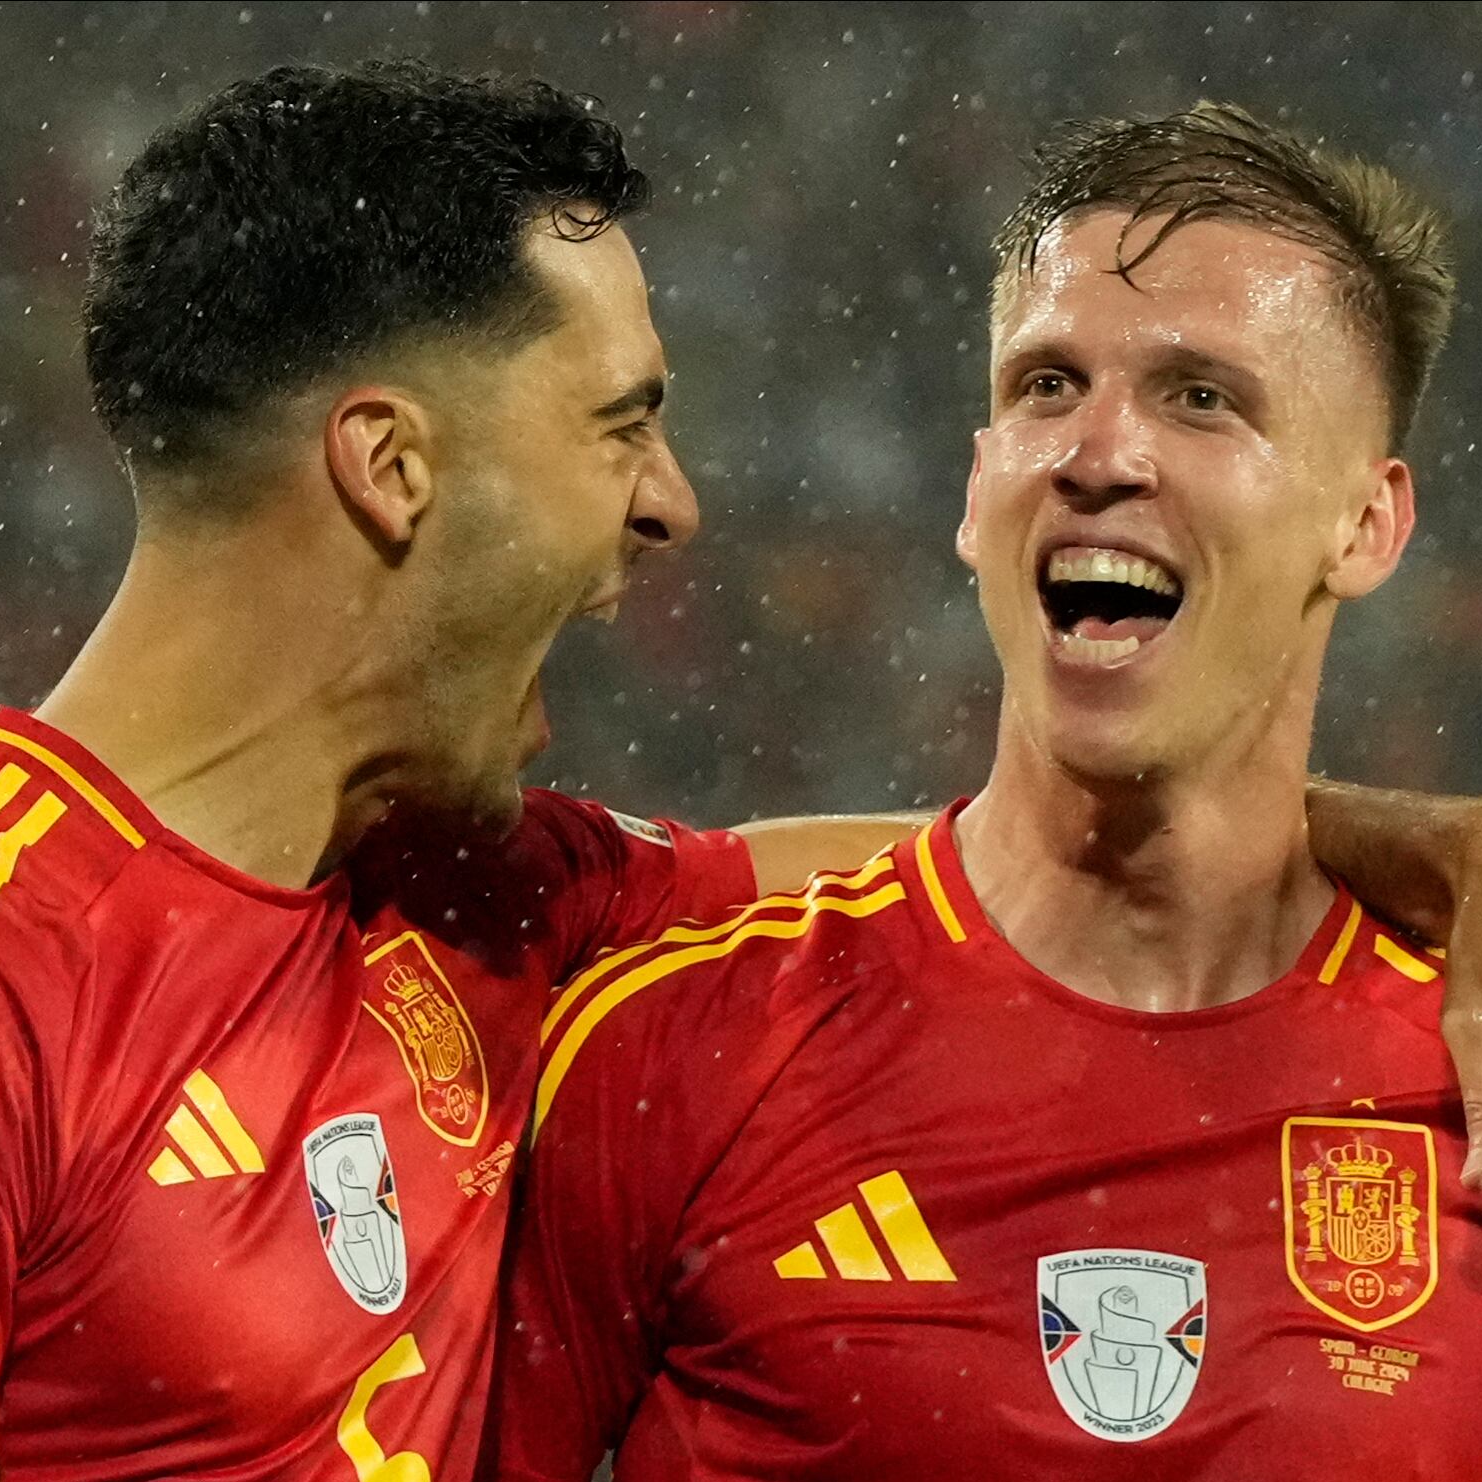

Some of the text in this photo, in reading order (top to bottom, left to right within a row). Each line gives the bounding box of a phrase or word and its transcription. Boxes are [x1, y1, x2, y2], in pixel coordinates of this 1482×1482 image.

[1046, 1255, 1197, 1276] UEFA NATIONS LEAGUE
[1083, 1411, 1134, 1433] WINNER
